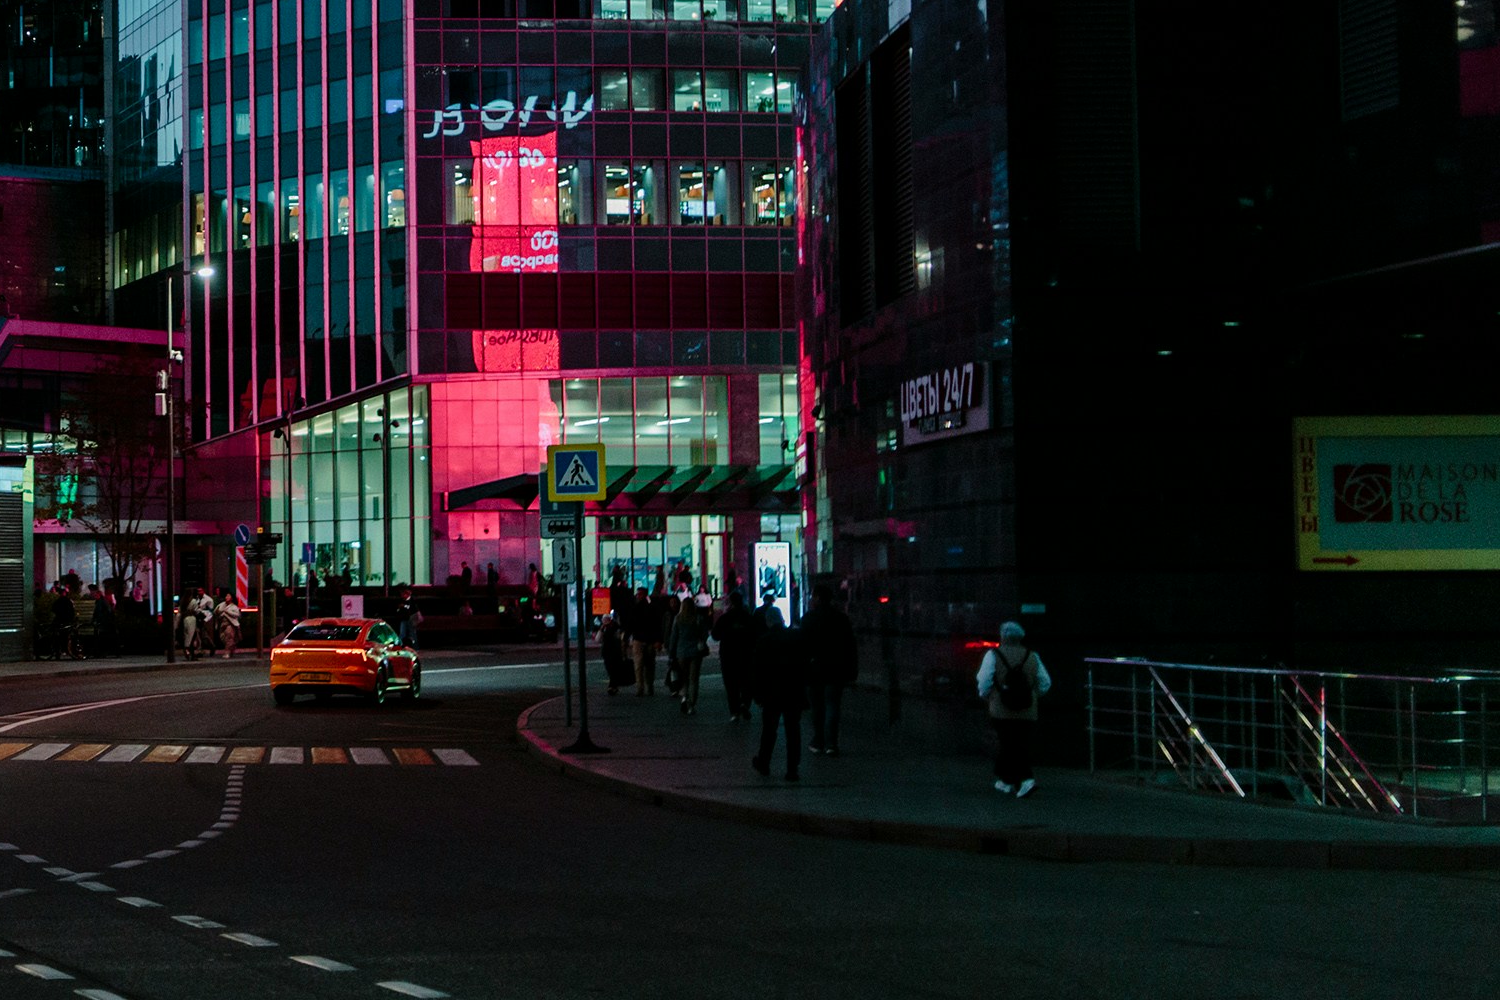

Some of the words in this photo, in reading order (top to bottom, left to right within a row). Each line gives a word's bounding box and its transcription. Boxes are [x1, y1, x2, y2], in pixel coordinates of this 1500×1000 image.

[901, 371, 940, 428] ЦВЕТЫ
[943, 362, 974, 412] 24/7
[1399, 463, 1497, 481] MAISON
[1400, 502, 1468, 523] ROSE
[558, 562, 570, 572] 25
